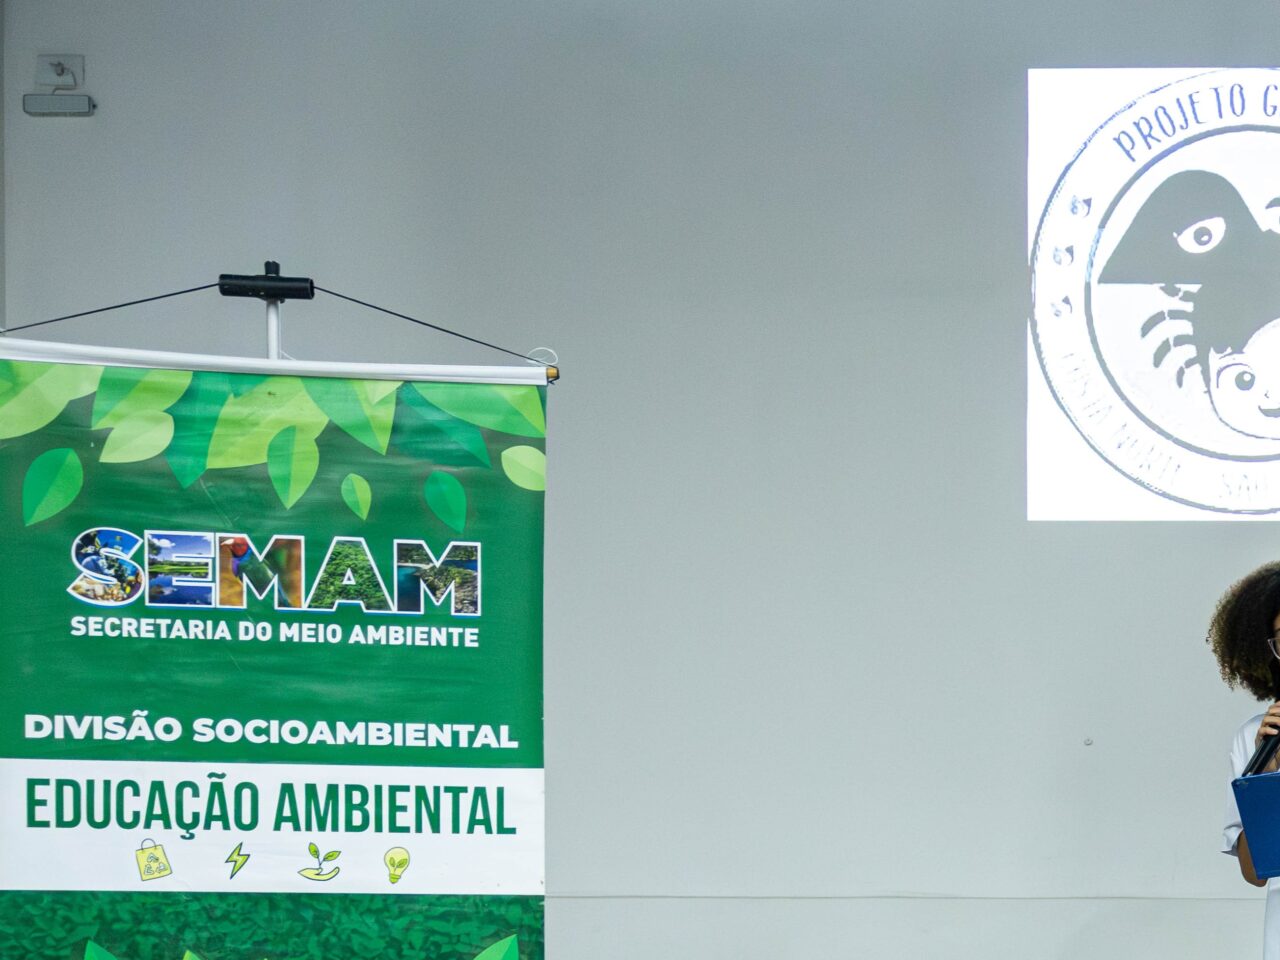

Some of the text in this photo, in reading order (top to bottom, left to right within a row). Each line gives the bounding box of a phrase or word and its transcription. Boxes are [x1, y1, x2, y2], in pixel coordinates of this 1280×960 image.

[1112, 83, 1247, 163] PROJETO
[66, 527, 481, 616] SEMAM
[70, 616, 479, 647] SECRETARIA DO MEIO AMBIENTE
[24, 710, 519, 748] DIVISÃO SOCIOAMBIENTAL
[26, 772, 517, 840] EDUCAÇÃO AMBIENTAL
